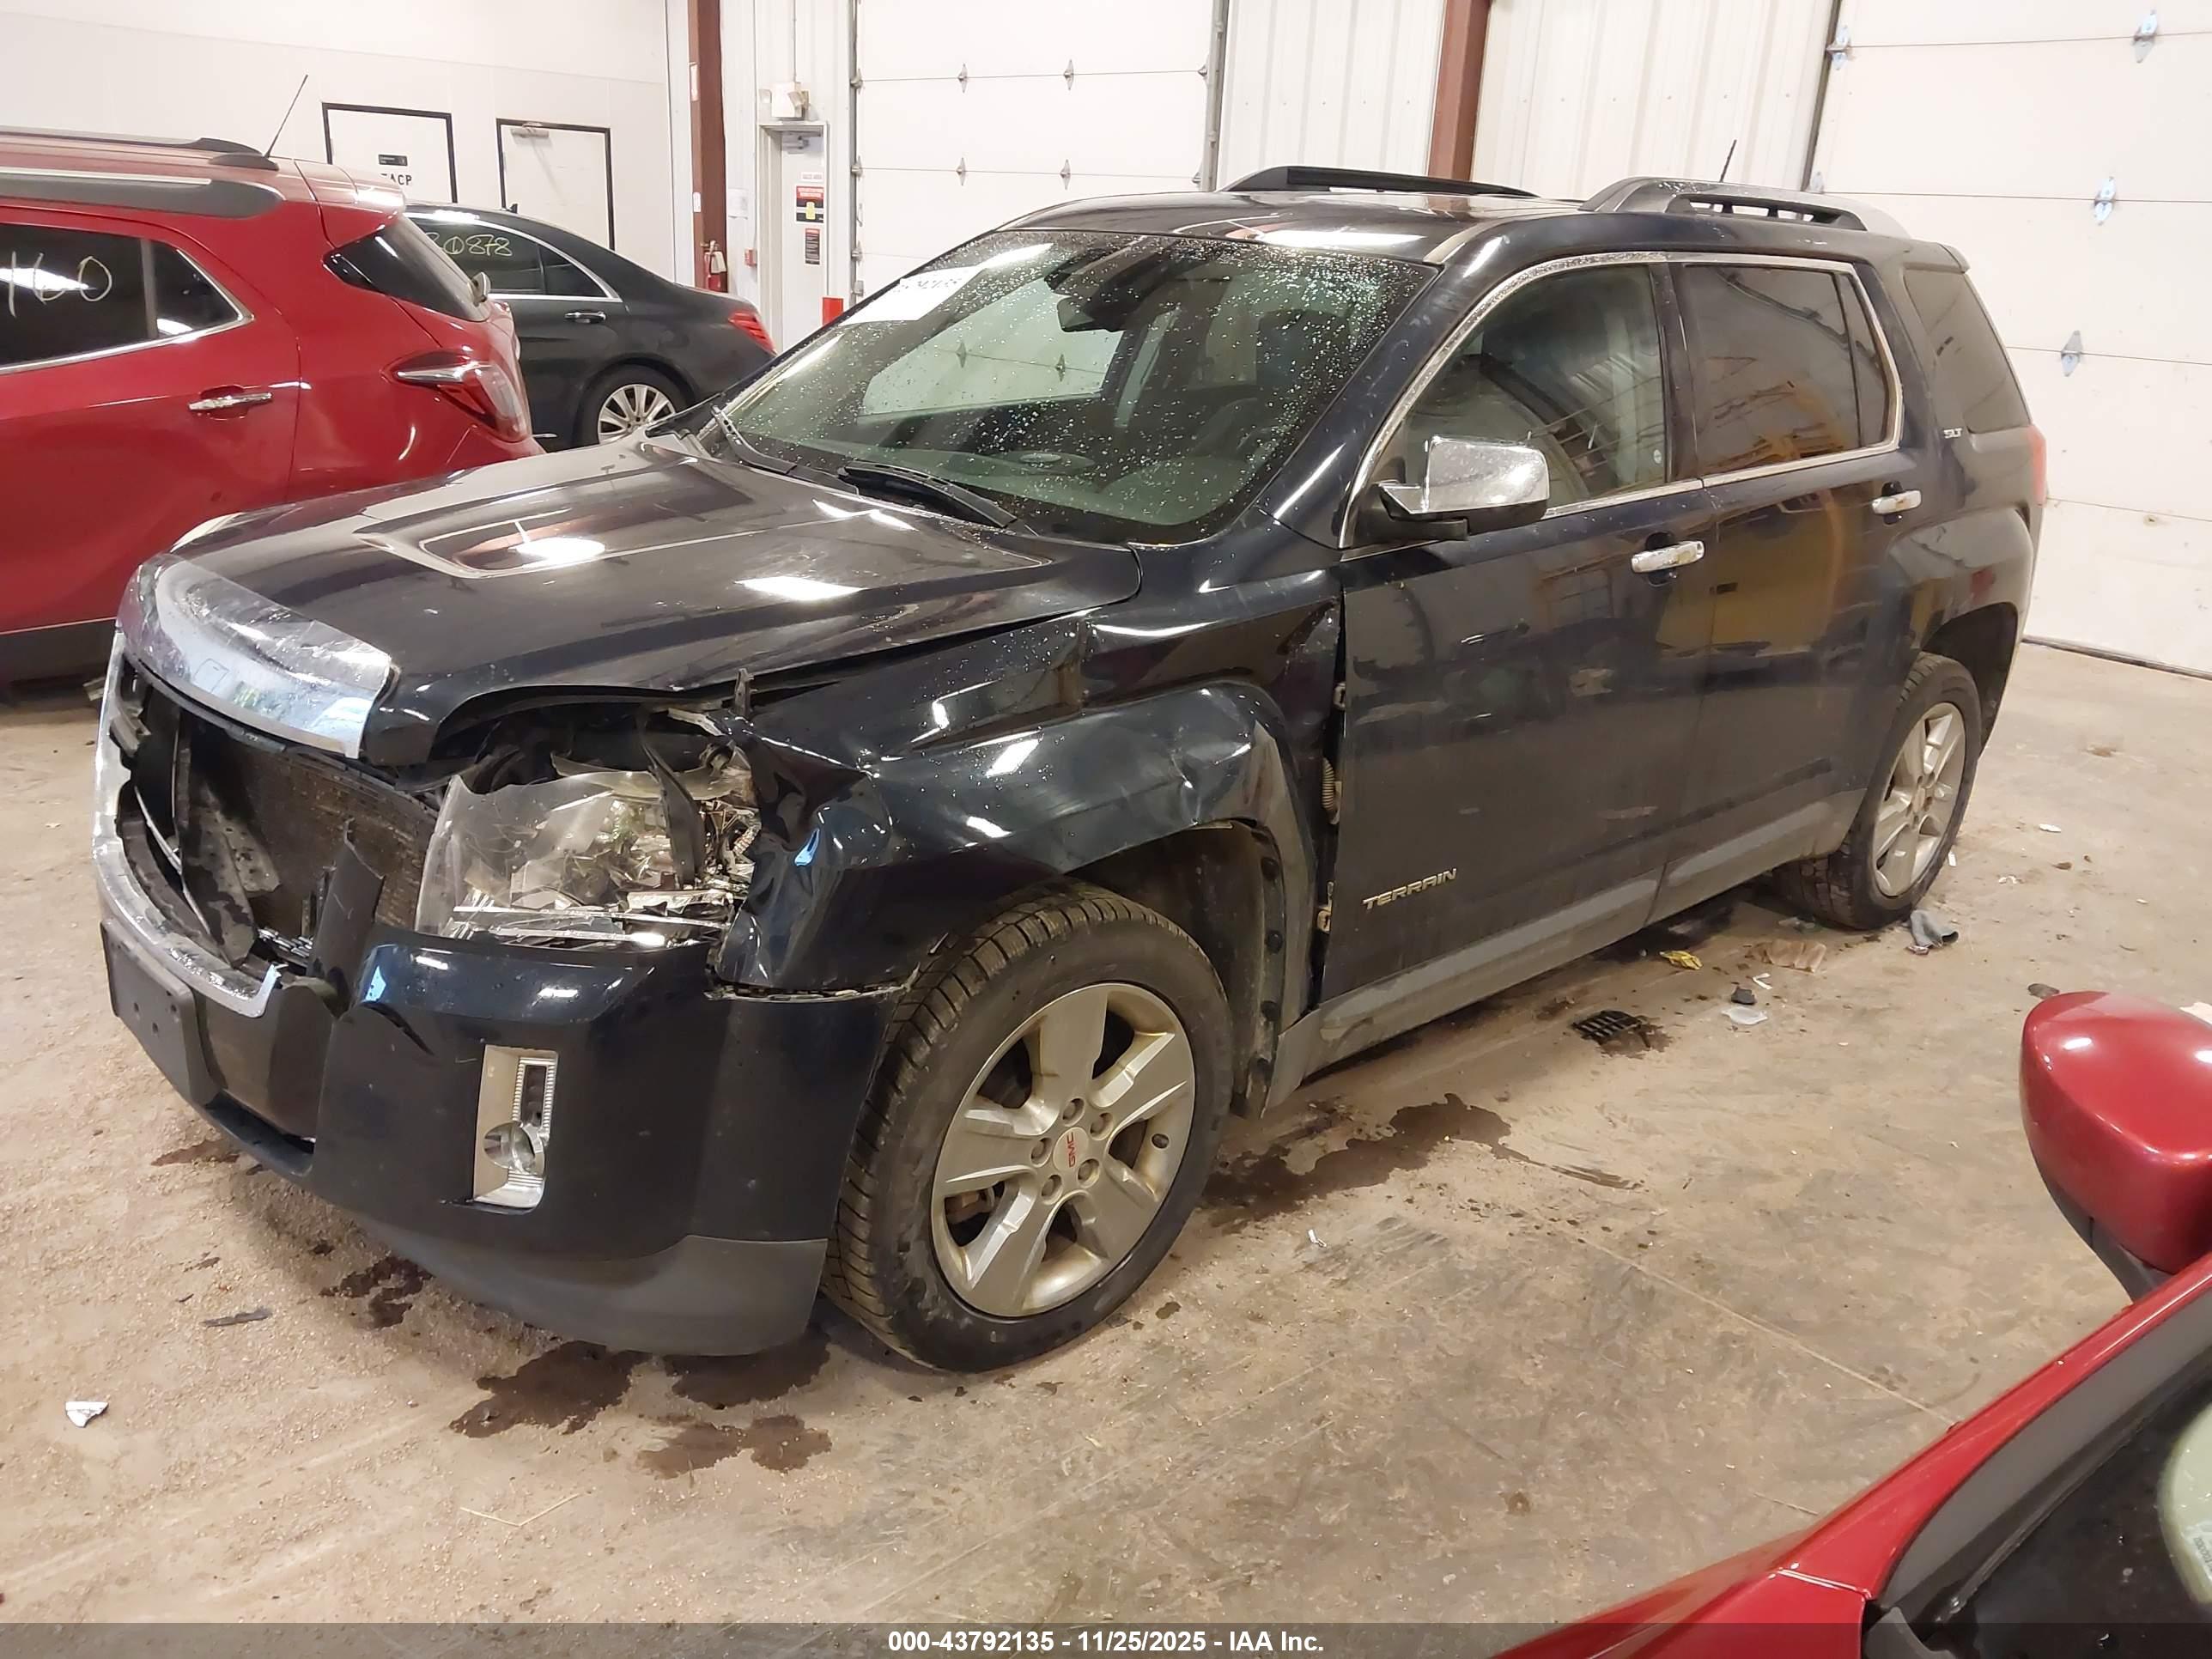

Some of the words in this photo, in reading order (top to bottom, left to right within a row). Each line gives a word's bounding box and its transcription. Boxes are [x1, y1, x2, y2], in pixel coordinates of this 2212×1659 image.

[1943, 428, 1963, 439] SLT
[1362, 867, 1457, 910] TERRAIN
[1066, 1131, 1076, 1168] GMC
